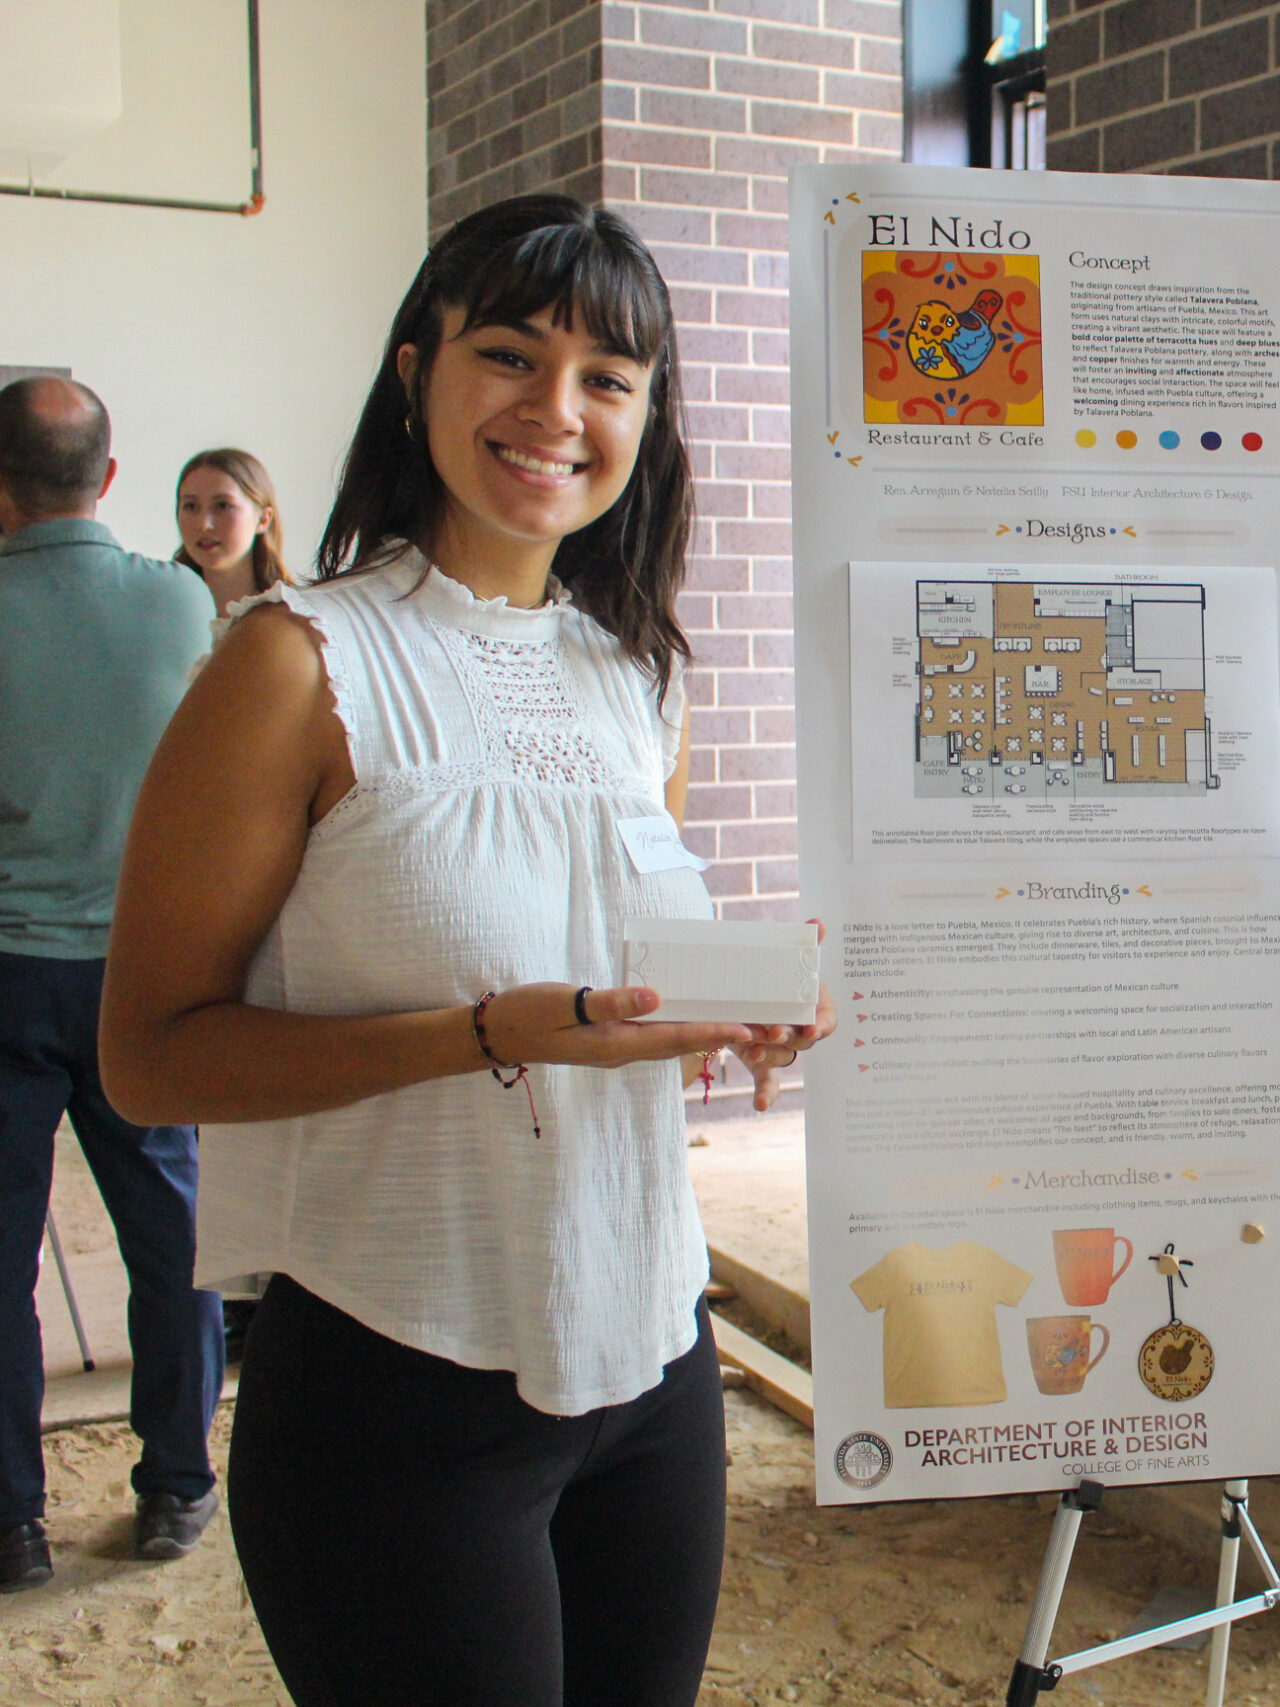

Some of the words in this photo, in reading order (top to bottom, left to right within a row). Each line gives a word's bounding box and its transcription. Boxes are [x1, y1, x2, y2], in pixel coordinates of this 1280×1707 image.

[868, 214, 910, 246] El
[929, 216, 1031, 250] Nido
[1069, 251, 1150, 274] Concept
[1070, 281, 1085, 289] The
[1086, 282, 1112, 292] design
[1114, 283, 1146, 293] concept
[1147, 284, 1172, 292] draws
[1173, 285, 1214, 296] inspiration
[1216, 286, 1235, 295] from
[1236, 287, 1250, 295] the
[1069, 291, 1111, 300] traditional
[1113, 293, 1142, 303] pottery
[1144, 294, 1163, 304] style
[1164, 294, 1188, 303] called
[1190, 295, 1224, 304] Talavera
[1225, 297, 1259, 306] Poblana,
[1070, 302, 1114, 313] originating
[1115, 304, 1134, 312] from
[1135, 304, 1166, 313] artisans
[1177, 306, 1206, 315] Puebla,
[1208, 306, 1238, 315] Mexico.
[1240, 308, 1256, 316] This
[1070, 312, 1090, 320] form
[1110, 313, 1139, 322] natural
[1140, 314, 1160, 324] clays
[1161, 315, 1180, 323] with
[1181, 316, 1216, 325] intricate,
[1217, 317, 1247, 325] colorful
[1248, 318, 1275, 327] motifs,
[868, 429, 972, 445] Restaurant
[978, 432, 992, 446] &
[1000, 431, 1044, 446] Cafe
[884, 485, 906, 495] Ren
[963, 486, 972, 495] &
[976, 486, 1016, 496] Natalia
[1062, 486, 1086, 497] FSU
[1091, 487, 1130, 498] Interior
[1133, 488, 1202, 499] Architecture
[1204, 489, 1213, 499] &
[1216, 489, 1253, 502] Design
[1026, 520, 1106, 544] Designs
[1038, 589, 1081, 597] EMPLOYEE
[1026, 882, 1121, 905] Branding
[852, 922, 873, 932] Nido
[874, 922, 882, 931] is
[890, 921, 909, 930] love
[910, 921, 934, 930] letter
[936, 920, 946, 929] to
[1014, 918, 1020, 927] It
[1022, 917, 1066, 927] celebrates
[1067, 916, 1101, 925] Puebla's
[1102, 916, 1118, 925] rich
[1152, 915, 1178, 924] where
[1179, 914, 1211, 925] Spanish
[989, 986, 1004, 995] the
[1040, 984, 1102, 995] representation
[1103, 983, 1113, 992] of
[1114, 982, 1149, 992] Mexican
[1150, 981, 1179, 991] culture
[1024, 1168, 1160, 1189] Merchandise
[905, 1422, 1057, 1447] DEPARTMENT
[1064, 1420, 1095, 1437] OF
[1102, 1412, 1208, 1435] INTERIOR
[921, 1439, 1097, 1467] ARCHITECTURE
[1104, 1438, 1119, 1454] &
[1126, 1432, 1208, 1454] DESIGN
[1062, 1460, 1121, 1476] COLLEGE
[1125, 1459, 1143, 1471] OF
[1147, 1457, 1175, 1469] FINE
[1177, 1455, 1209, 1468] ARTS
